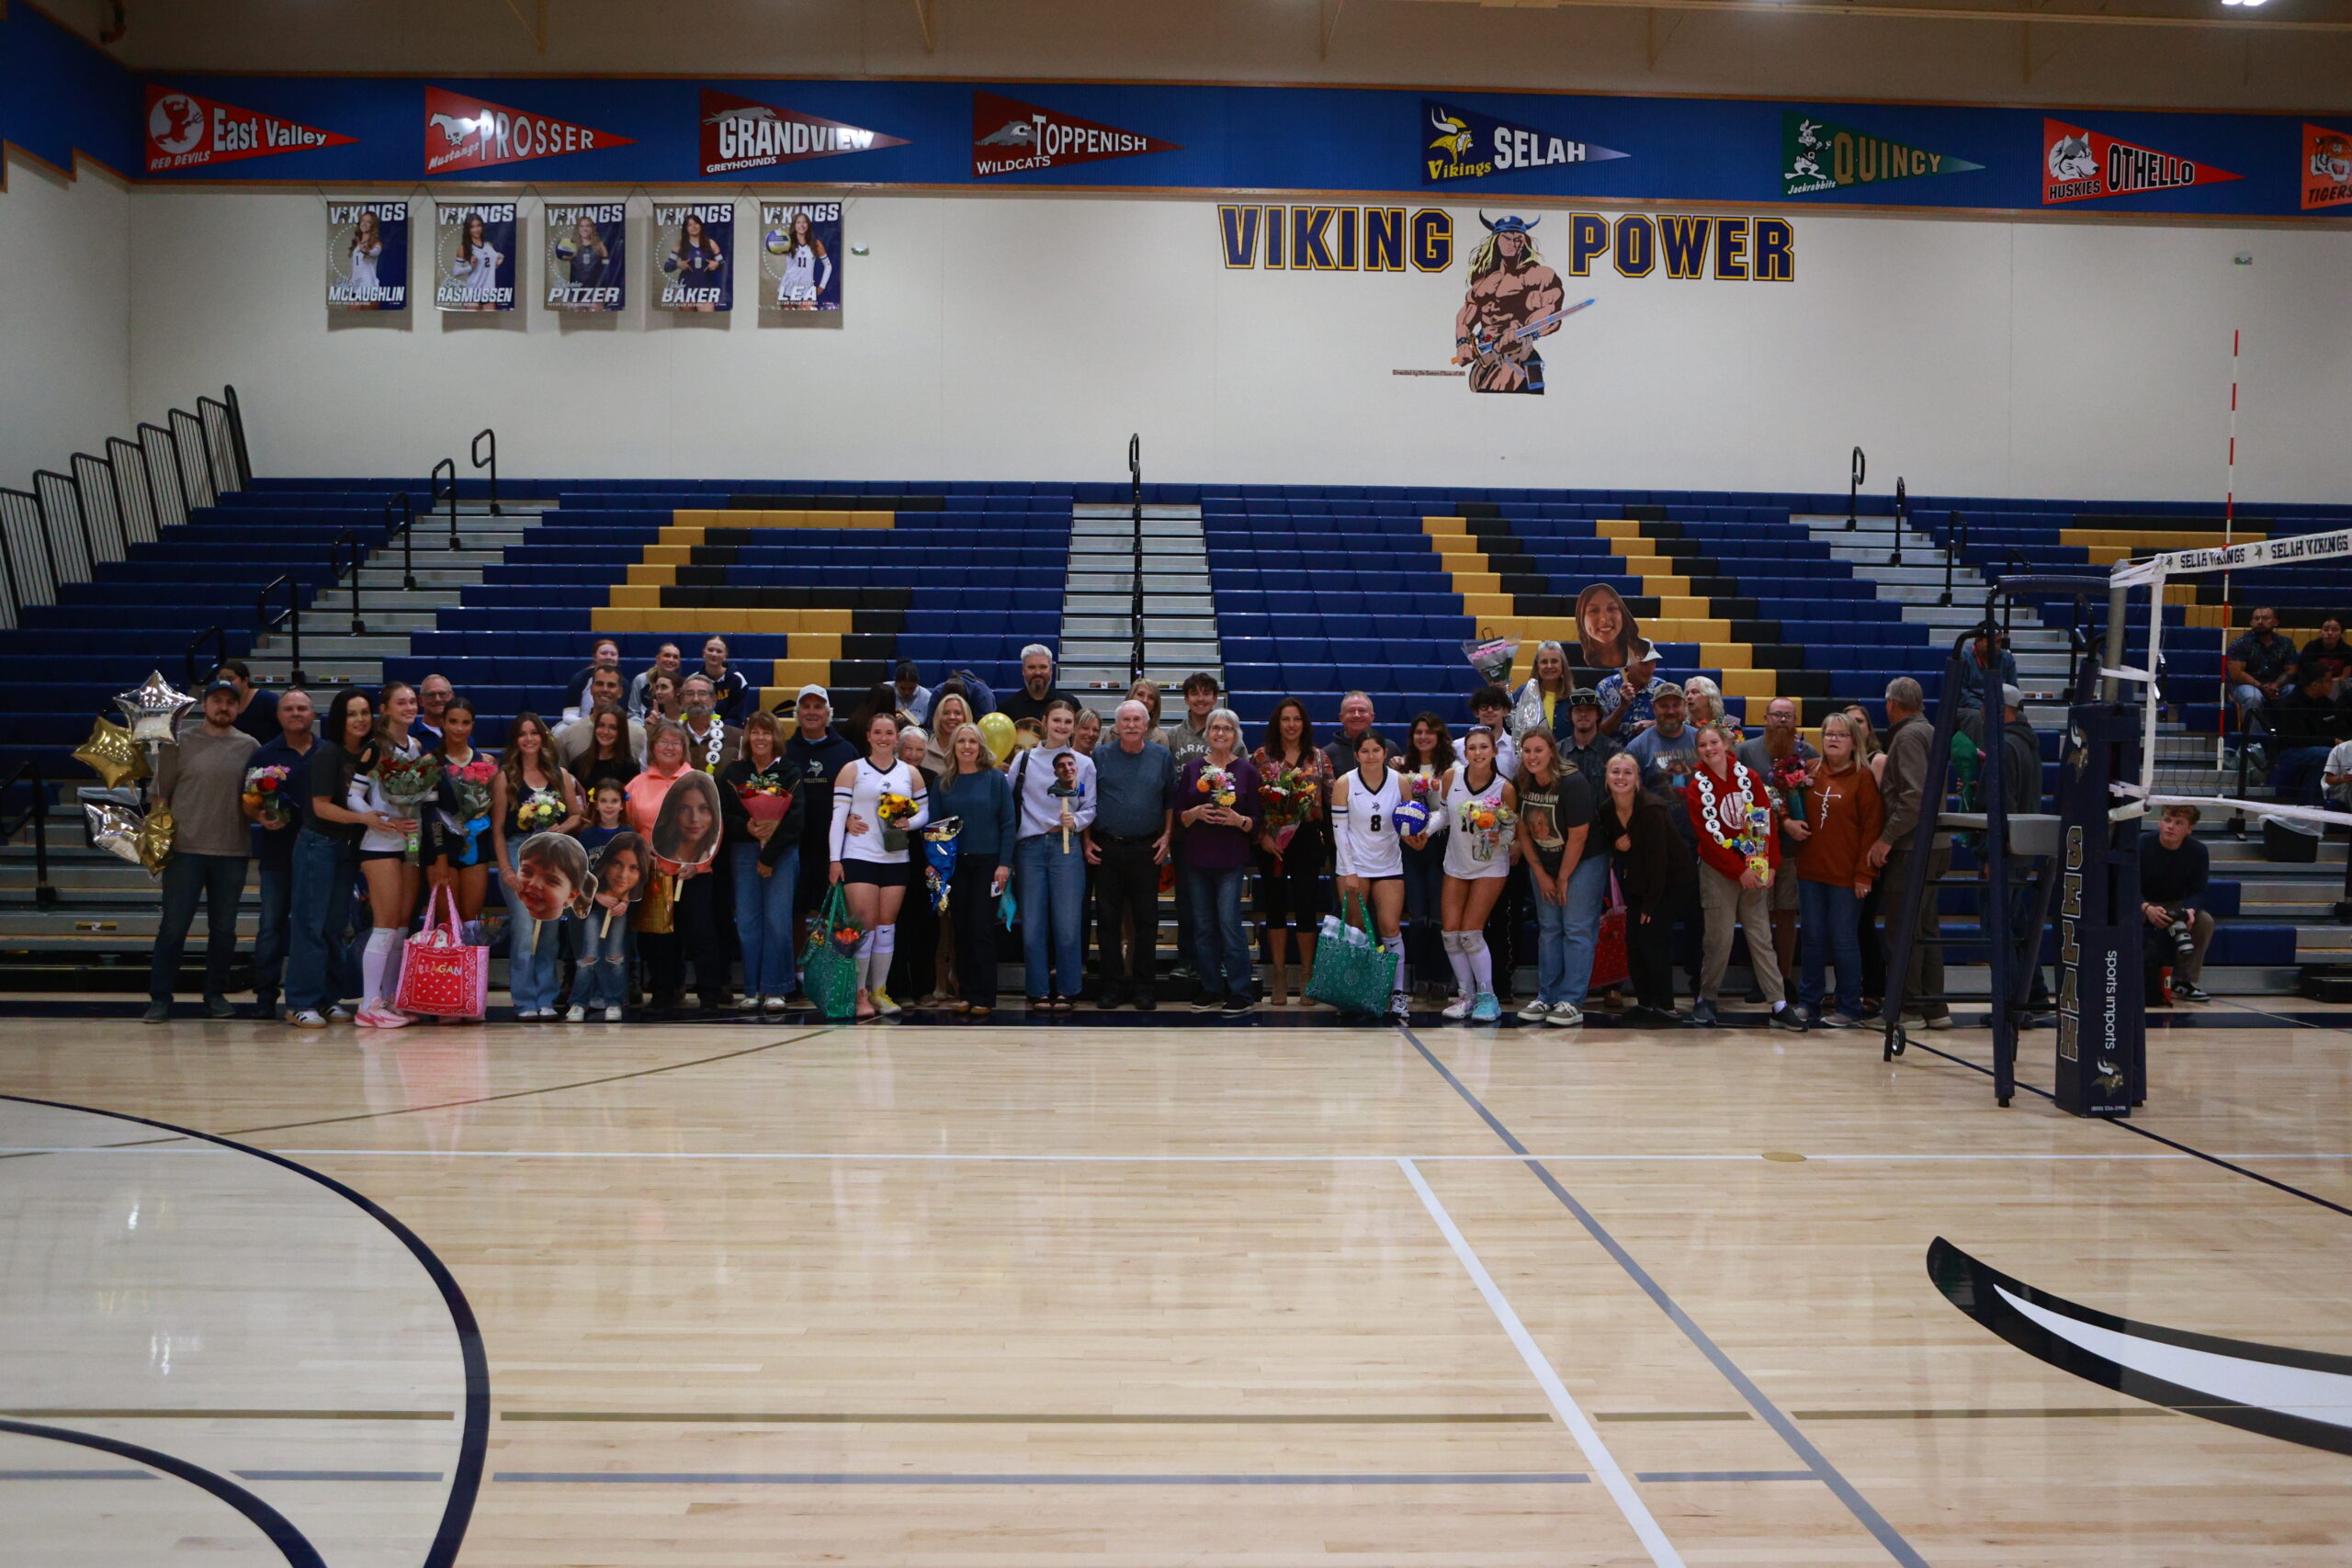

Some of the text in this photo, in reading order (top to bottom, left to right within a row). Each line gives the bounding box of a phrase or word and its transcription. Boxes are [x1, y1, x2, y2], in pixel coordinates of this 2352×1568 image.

[213, 107, 328, 152] East Valley
[481, 107, 594, 161] PROSSER
[719, 116, 876, 160] GRANDVIEW
[1033, 112, 1148, 156] TOPPENISH
[428, 141, 481, 170] Mustangs
[1494, 126, 1586, 170] SELAH
[151, 150, 211, 169] RED DEVILS
[707, 156, 777, 174] GREYHOUNDS
[977, 155, 1051, 175] WILDCATS
[1834, 131, 1941, 186] QUINCY
[2107, 142, 2195, 192] OTHELLO
[1428, 159, 1492, 180] Vikings
[1787, 179, 1837, 195] Jackrabbits
[2048, 180, 2102, 200] HUSKIES
[1217, 204, 1453, 273] VIKING
[1568, 212, 1794, 282] POWER
[484, 257, 490, 267] 2
[797, 257, 807, 268] 11
[328, 286, 405, 301] MCLAUGHLIN
[436, 287, 513, 302] RASMUSSEN
[548, 287, 620, 302] PITZER
[662, 288, 721, 303] BAKER
[777, 286, 817, 301] LEA
[2270, 535, 2348, 559] SELAH VIKINGS
[2180, 553, 2208, 569] SELAH
[1175, 743, 1213, 760] PARKE
[1370, 814, 1382, 832] 8
[2060, 825, 2083, 1062] SELAH
[2103, 950, 2118, 1050] sports imports
